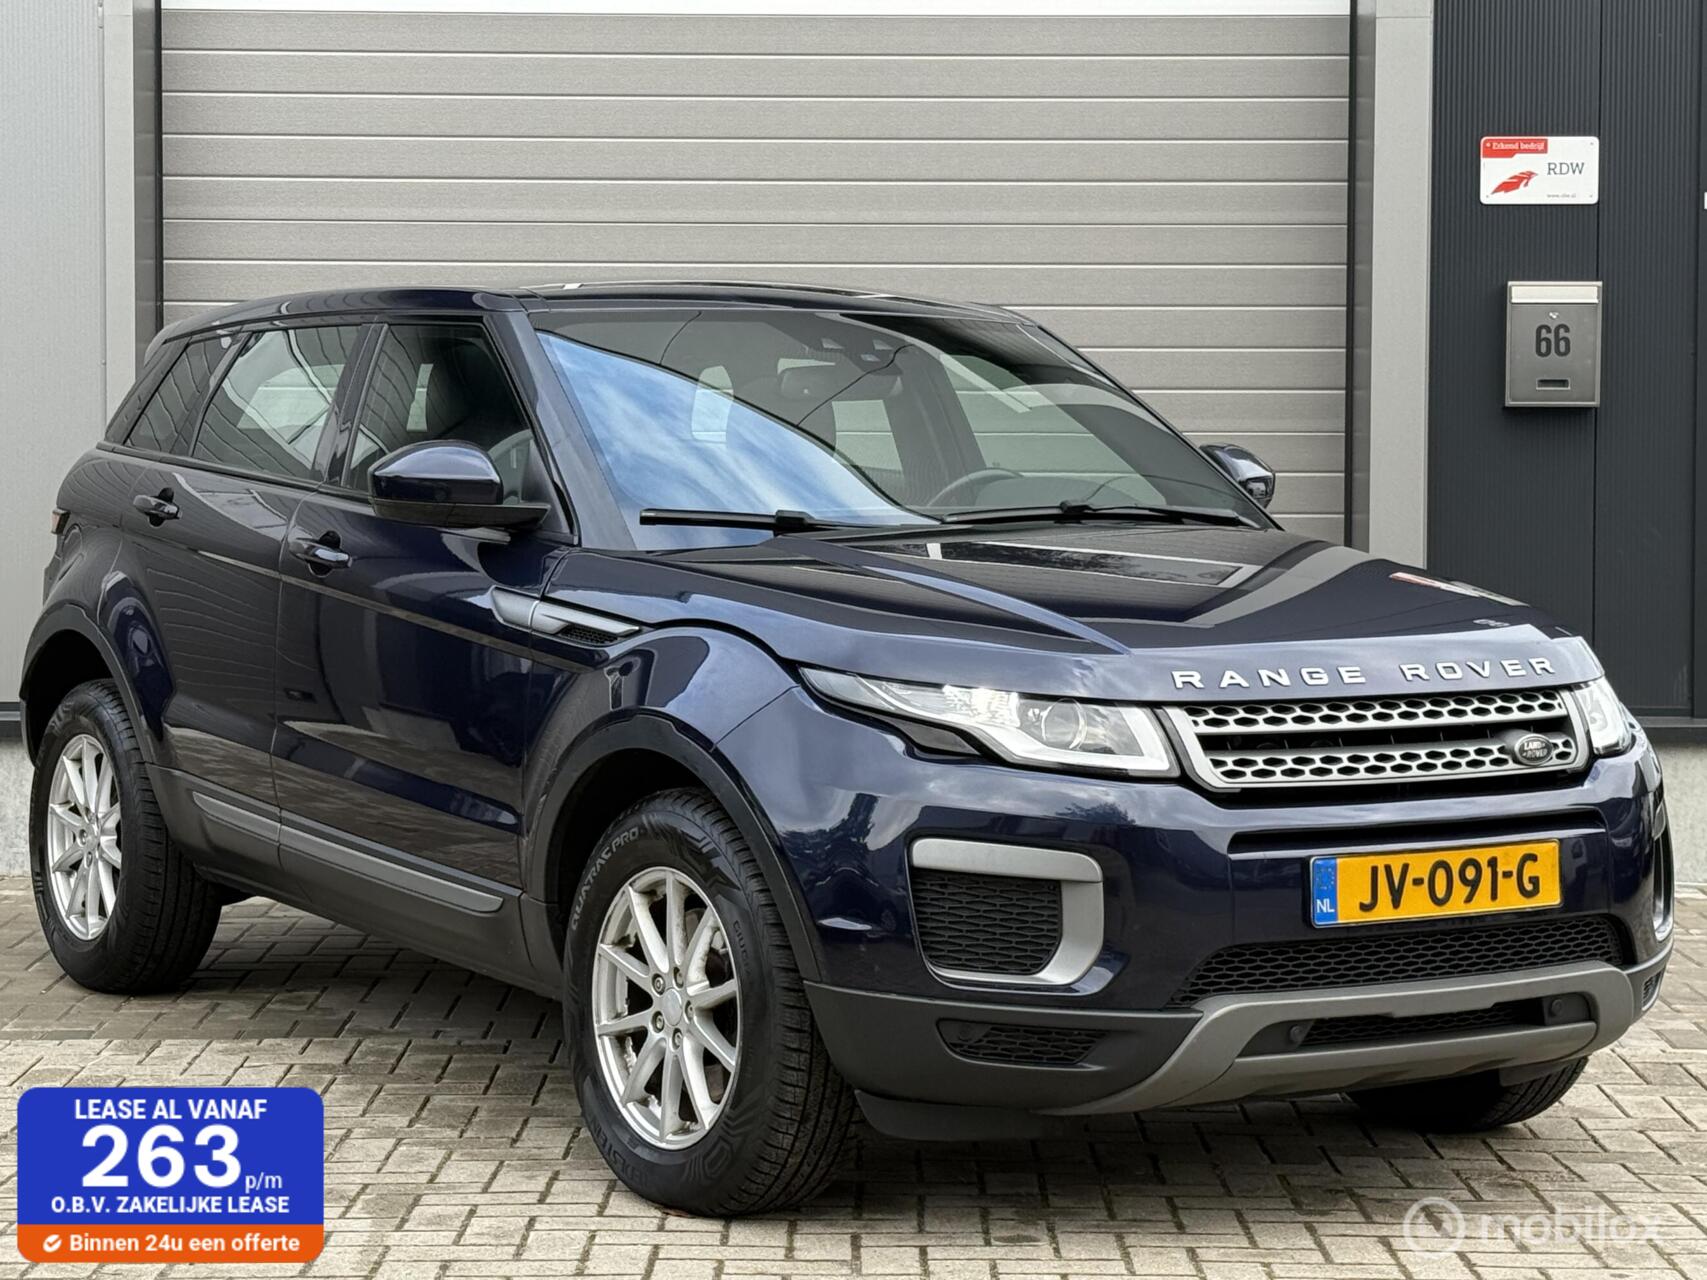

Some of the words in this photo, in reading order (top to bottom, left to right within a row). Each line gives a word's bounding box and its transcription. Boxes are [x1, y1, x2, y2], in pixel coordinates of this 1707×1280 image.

[1546, 161, 1585, 176] RDW
[1535, 323, 1571, 358] 66
[1171, 666, 1367, 689] RANGE
[1399, 657, 1556, 682] ROVER
[571, 846, 612, 931] QUATRAC
[611, 826, 639, 853] PRO
[1359, 853, 1541, 913] JV-091-G
[1316, 898, 1335, 913] NL
